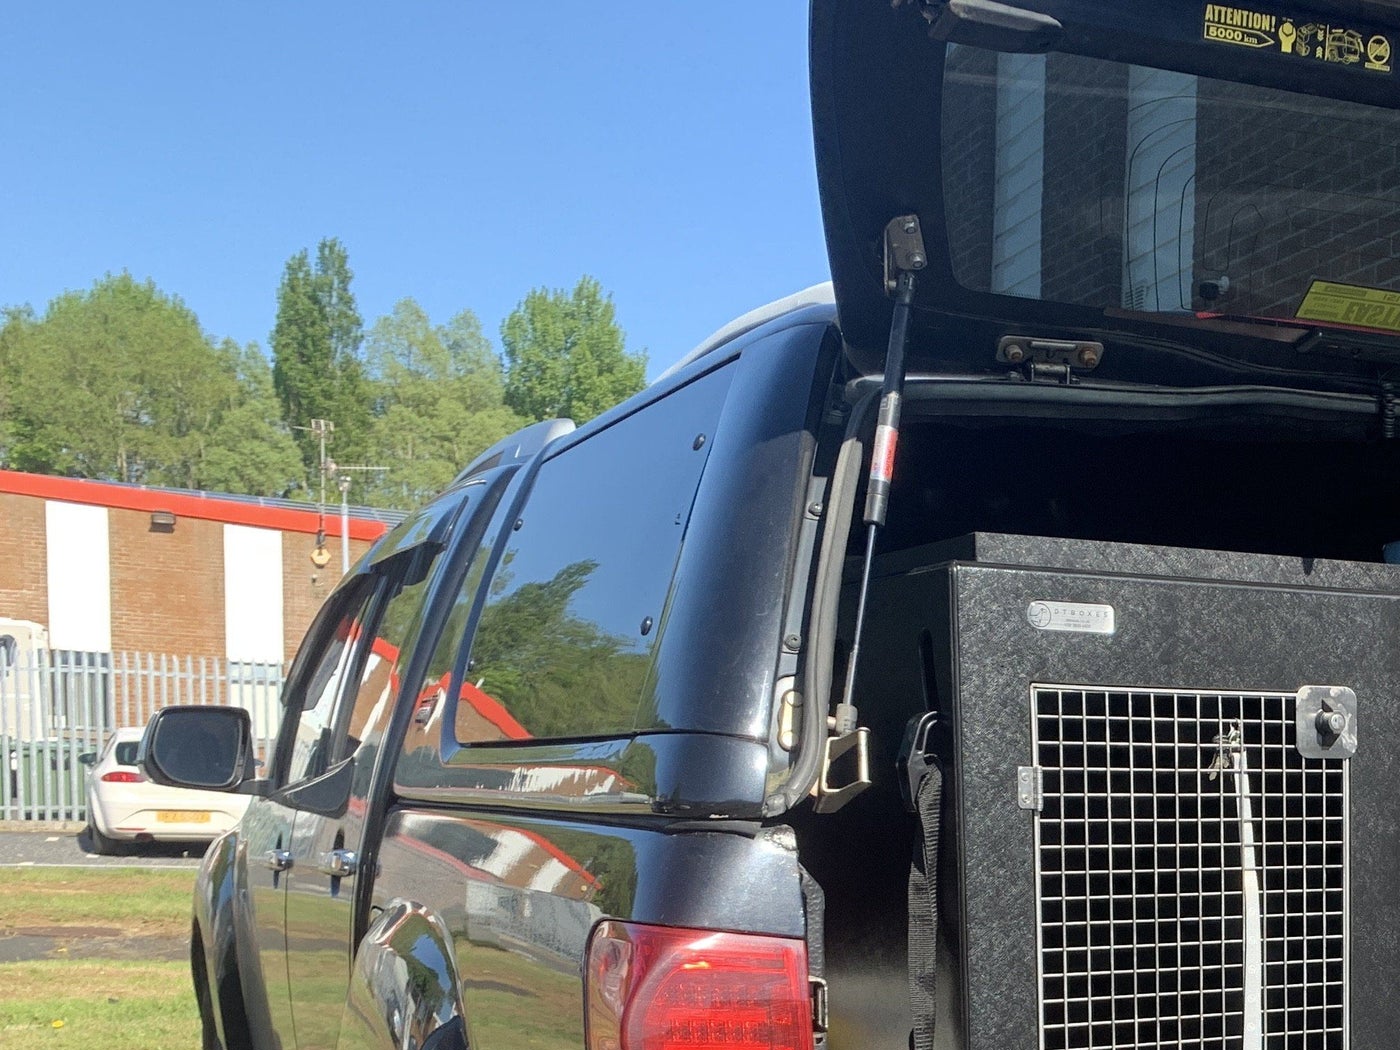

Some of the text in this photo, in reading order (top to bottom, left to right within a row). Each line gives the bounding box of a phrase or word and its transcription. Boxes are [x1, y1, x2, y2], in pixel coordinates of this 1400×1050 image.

[1205, 4, 1276, 32] ATTENTION!
[1209, 26, 1258, 45] 5000 km
